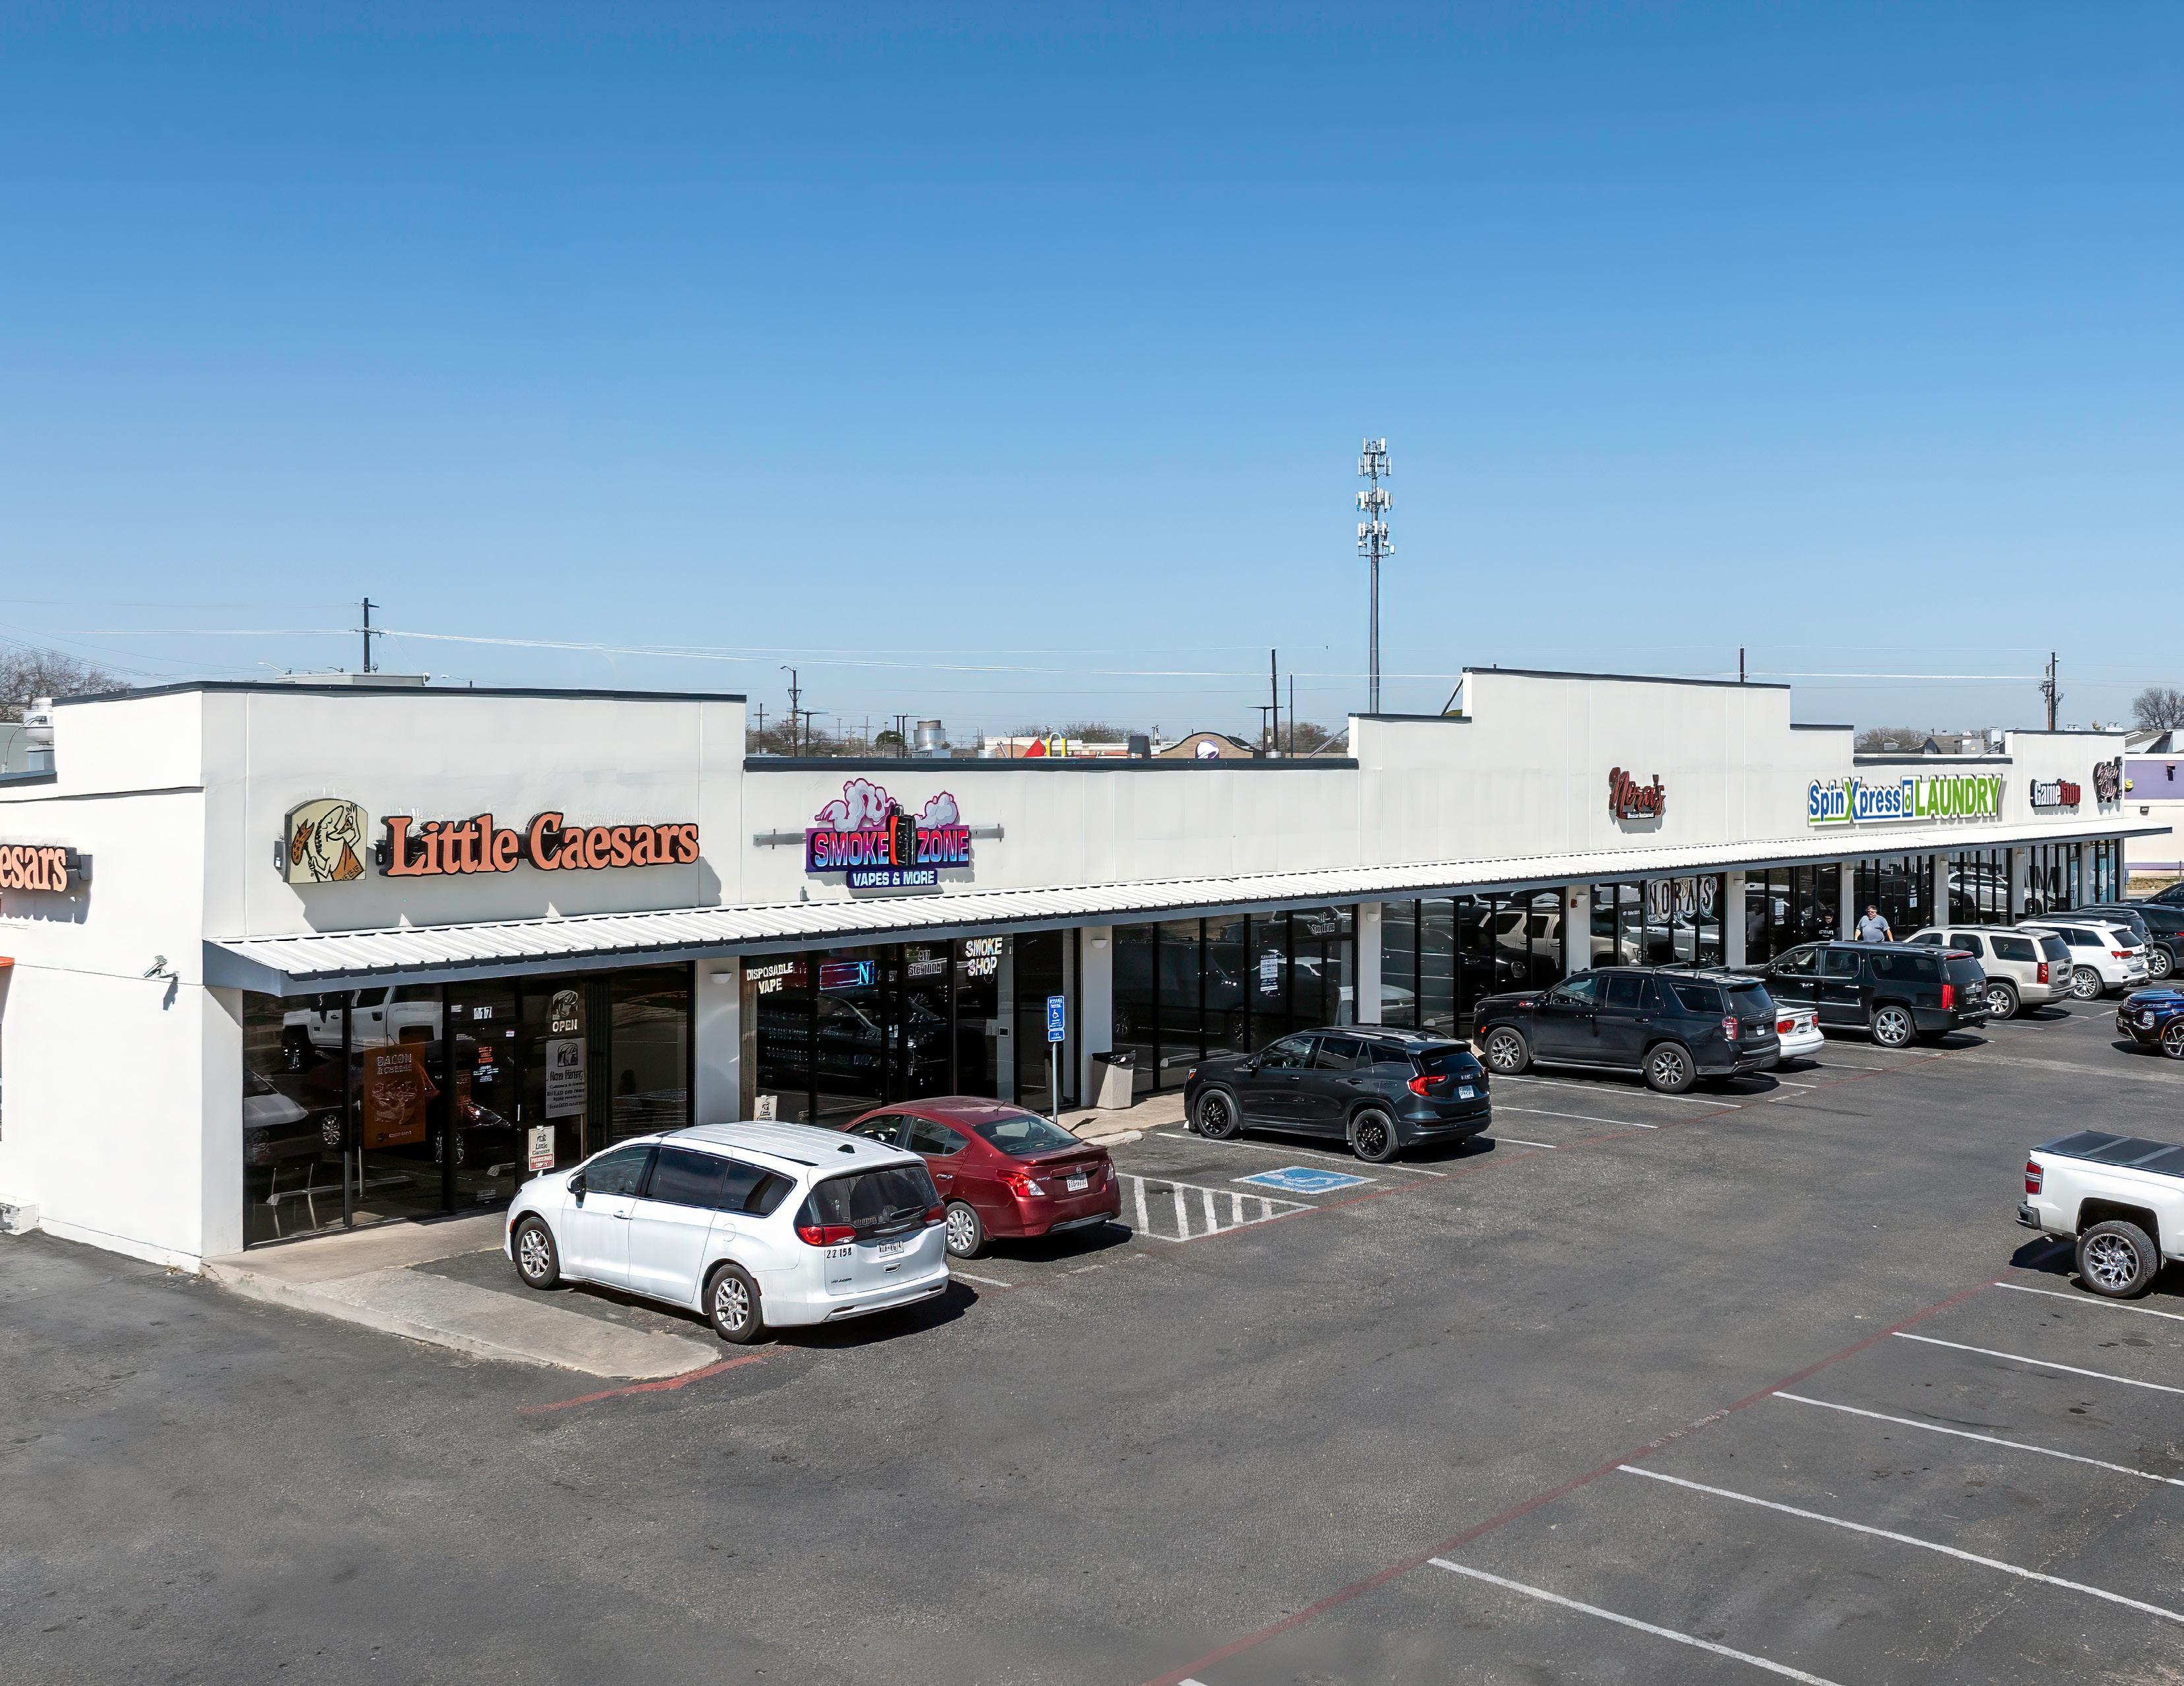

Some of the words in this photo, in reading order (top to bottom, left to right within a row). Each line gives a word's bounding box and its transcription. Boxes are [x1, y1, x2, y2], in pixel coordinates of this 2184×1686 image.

[1915, 777, 2001, 820] LAUNDRY
[385, 813, 519, 877] Little
[529, 811, 700, 870] Caesars
[814, 831, 889, 867] SMOKE
[916, 829, 969, 863] ZONE
[852, 872, 889, 886] VAPES
[892, 872, 901, 885] &
[903, 870, 935, 885] MORE
[965, 937, 1003, 957] SMOKE
[746, 962, 794, 981] DISPOSABLE
[968, 956, 997, 976] SHOP
[758, 978, 783, 994] VAPE
[552, 1019, 577, 1032] OPEN
[826, 1249, 837, 1258] 22
[839, 1247, 852, 1258] 158
